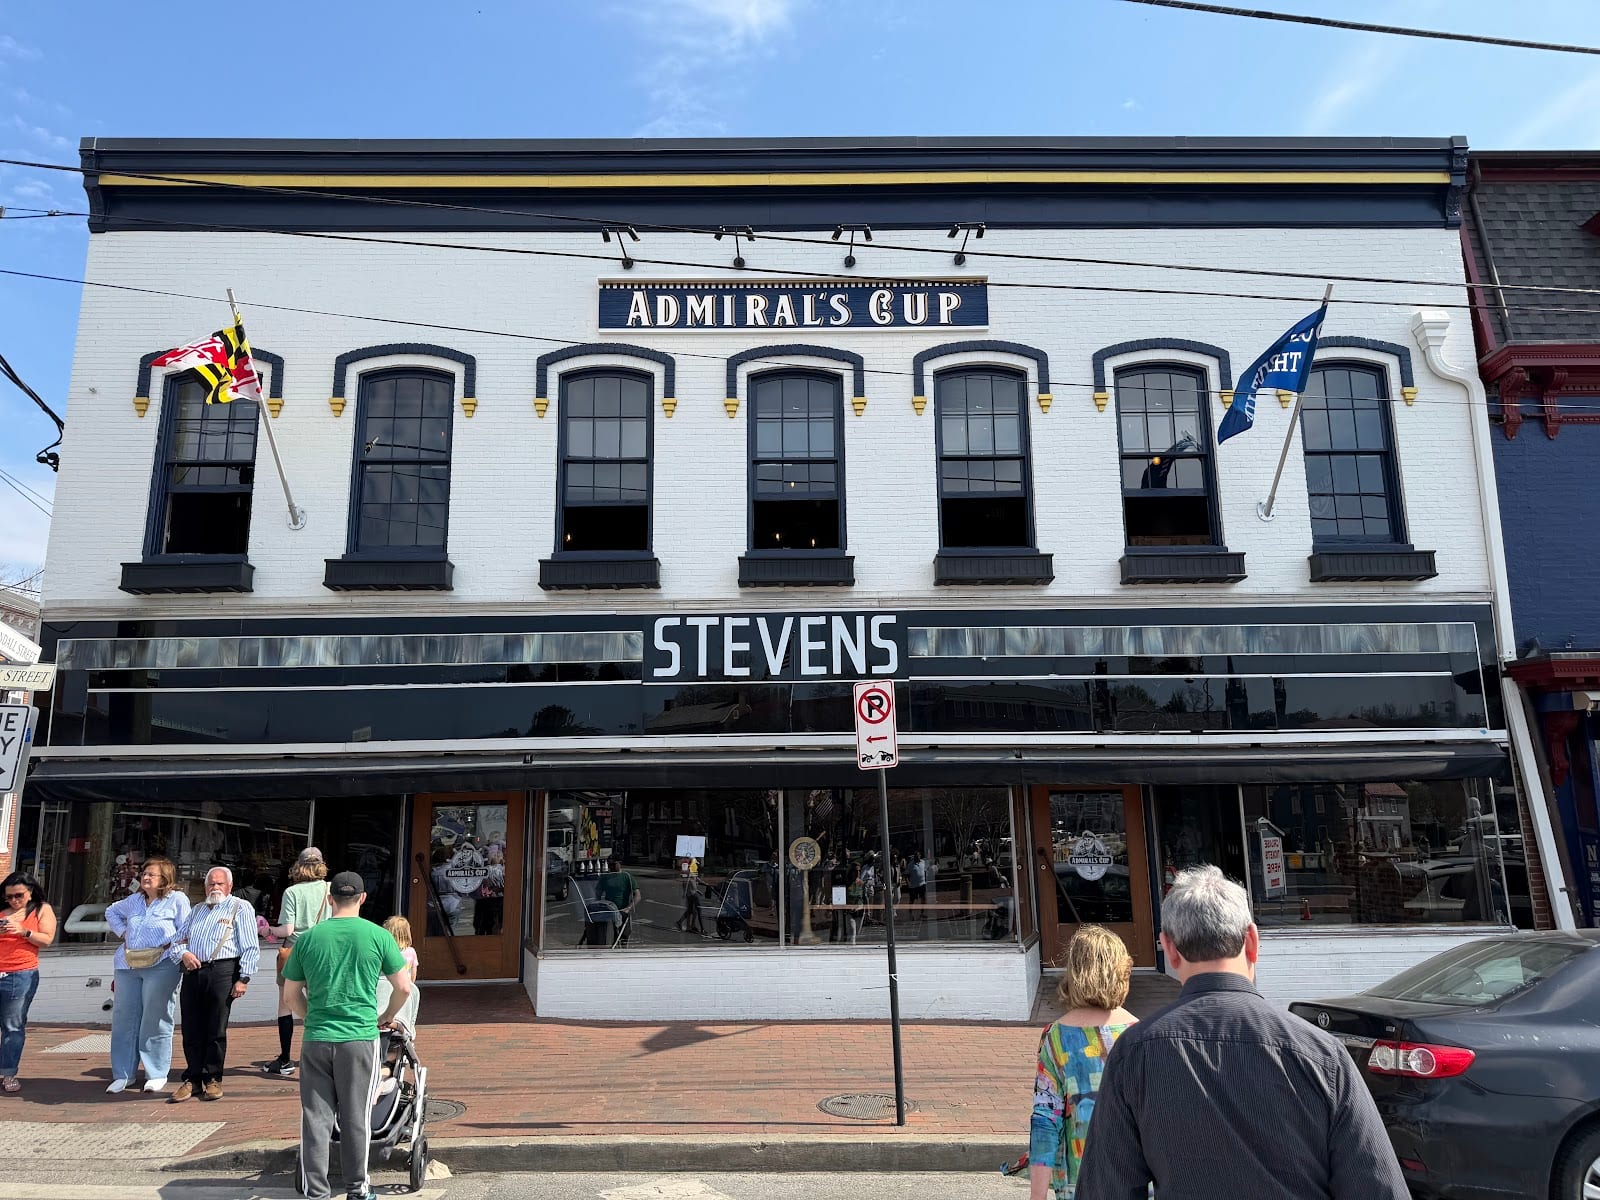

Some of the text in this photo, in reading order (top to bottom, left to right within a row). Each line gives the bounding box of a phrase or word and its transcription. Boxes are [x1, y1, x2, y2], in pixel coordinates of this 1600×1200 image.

[625, 288, 962, 327] ADMIRAL'S CUP
[0, 631, 38, 663] DALL STREET
[653, 615, 898, 677] STEVENS
[3, 670, 51, 683] STREET
